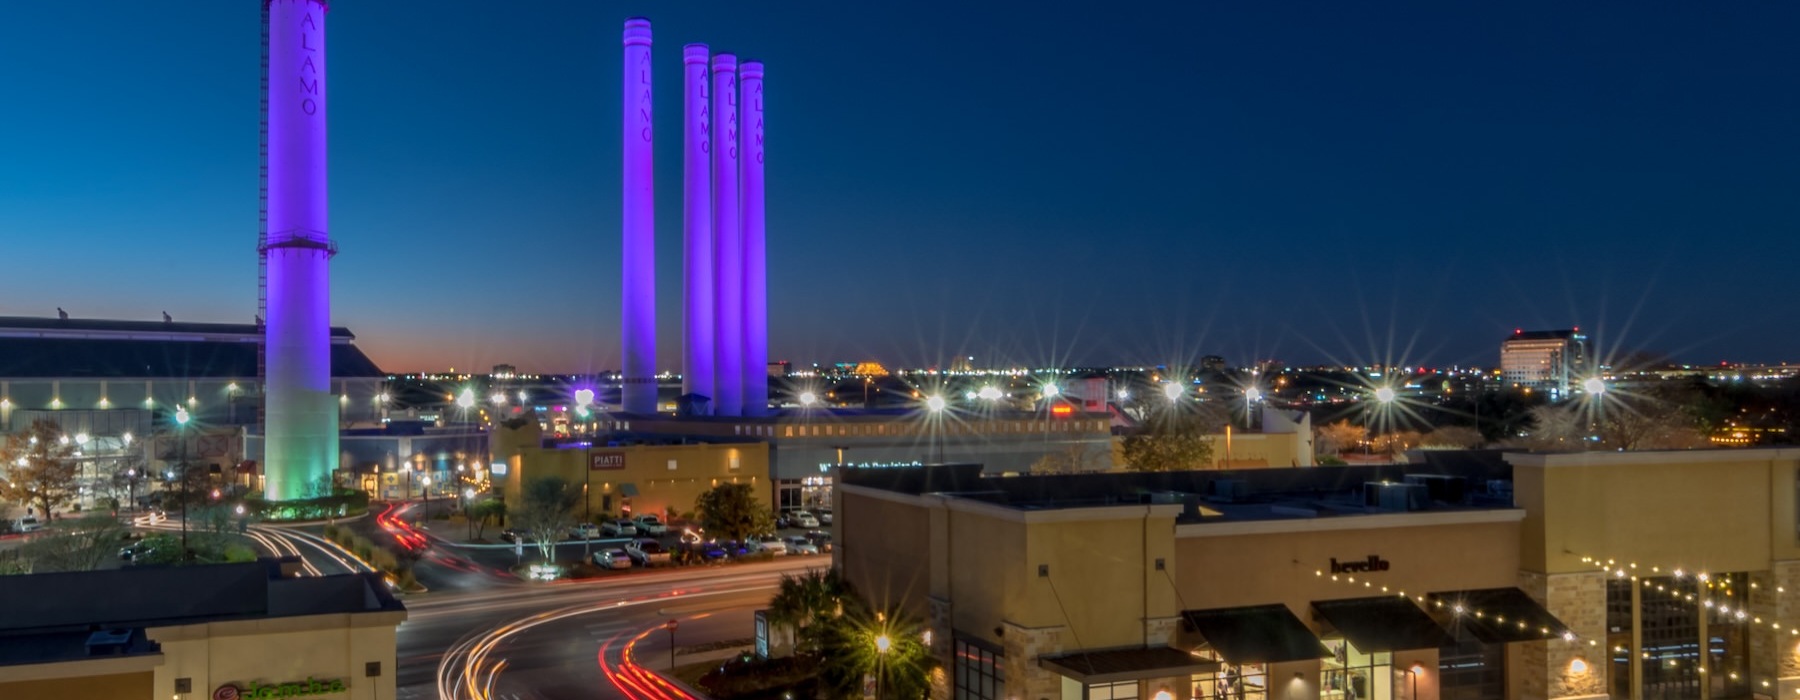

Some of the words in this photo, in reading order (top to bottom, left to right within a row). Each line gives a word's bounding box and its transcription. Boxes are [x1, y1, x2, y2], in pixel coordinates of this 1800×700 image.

[299, 12, 317, 116] ALAMO
[641, 51, 652, 142] ALAMO
[700, 68, 709, 153] ALAMO
[728, 76, 737, 159] ALAMO
[755, 83, 764, 163] ALAMO
[594, 455, 623, 465] PIATTI
